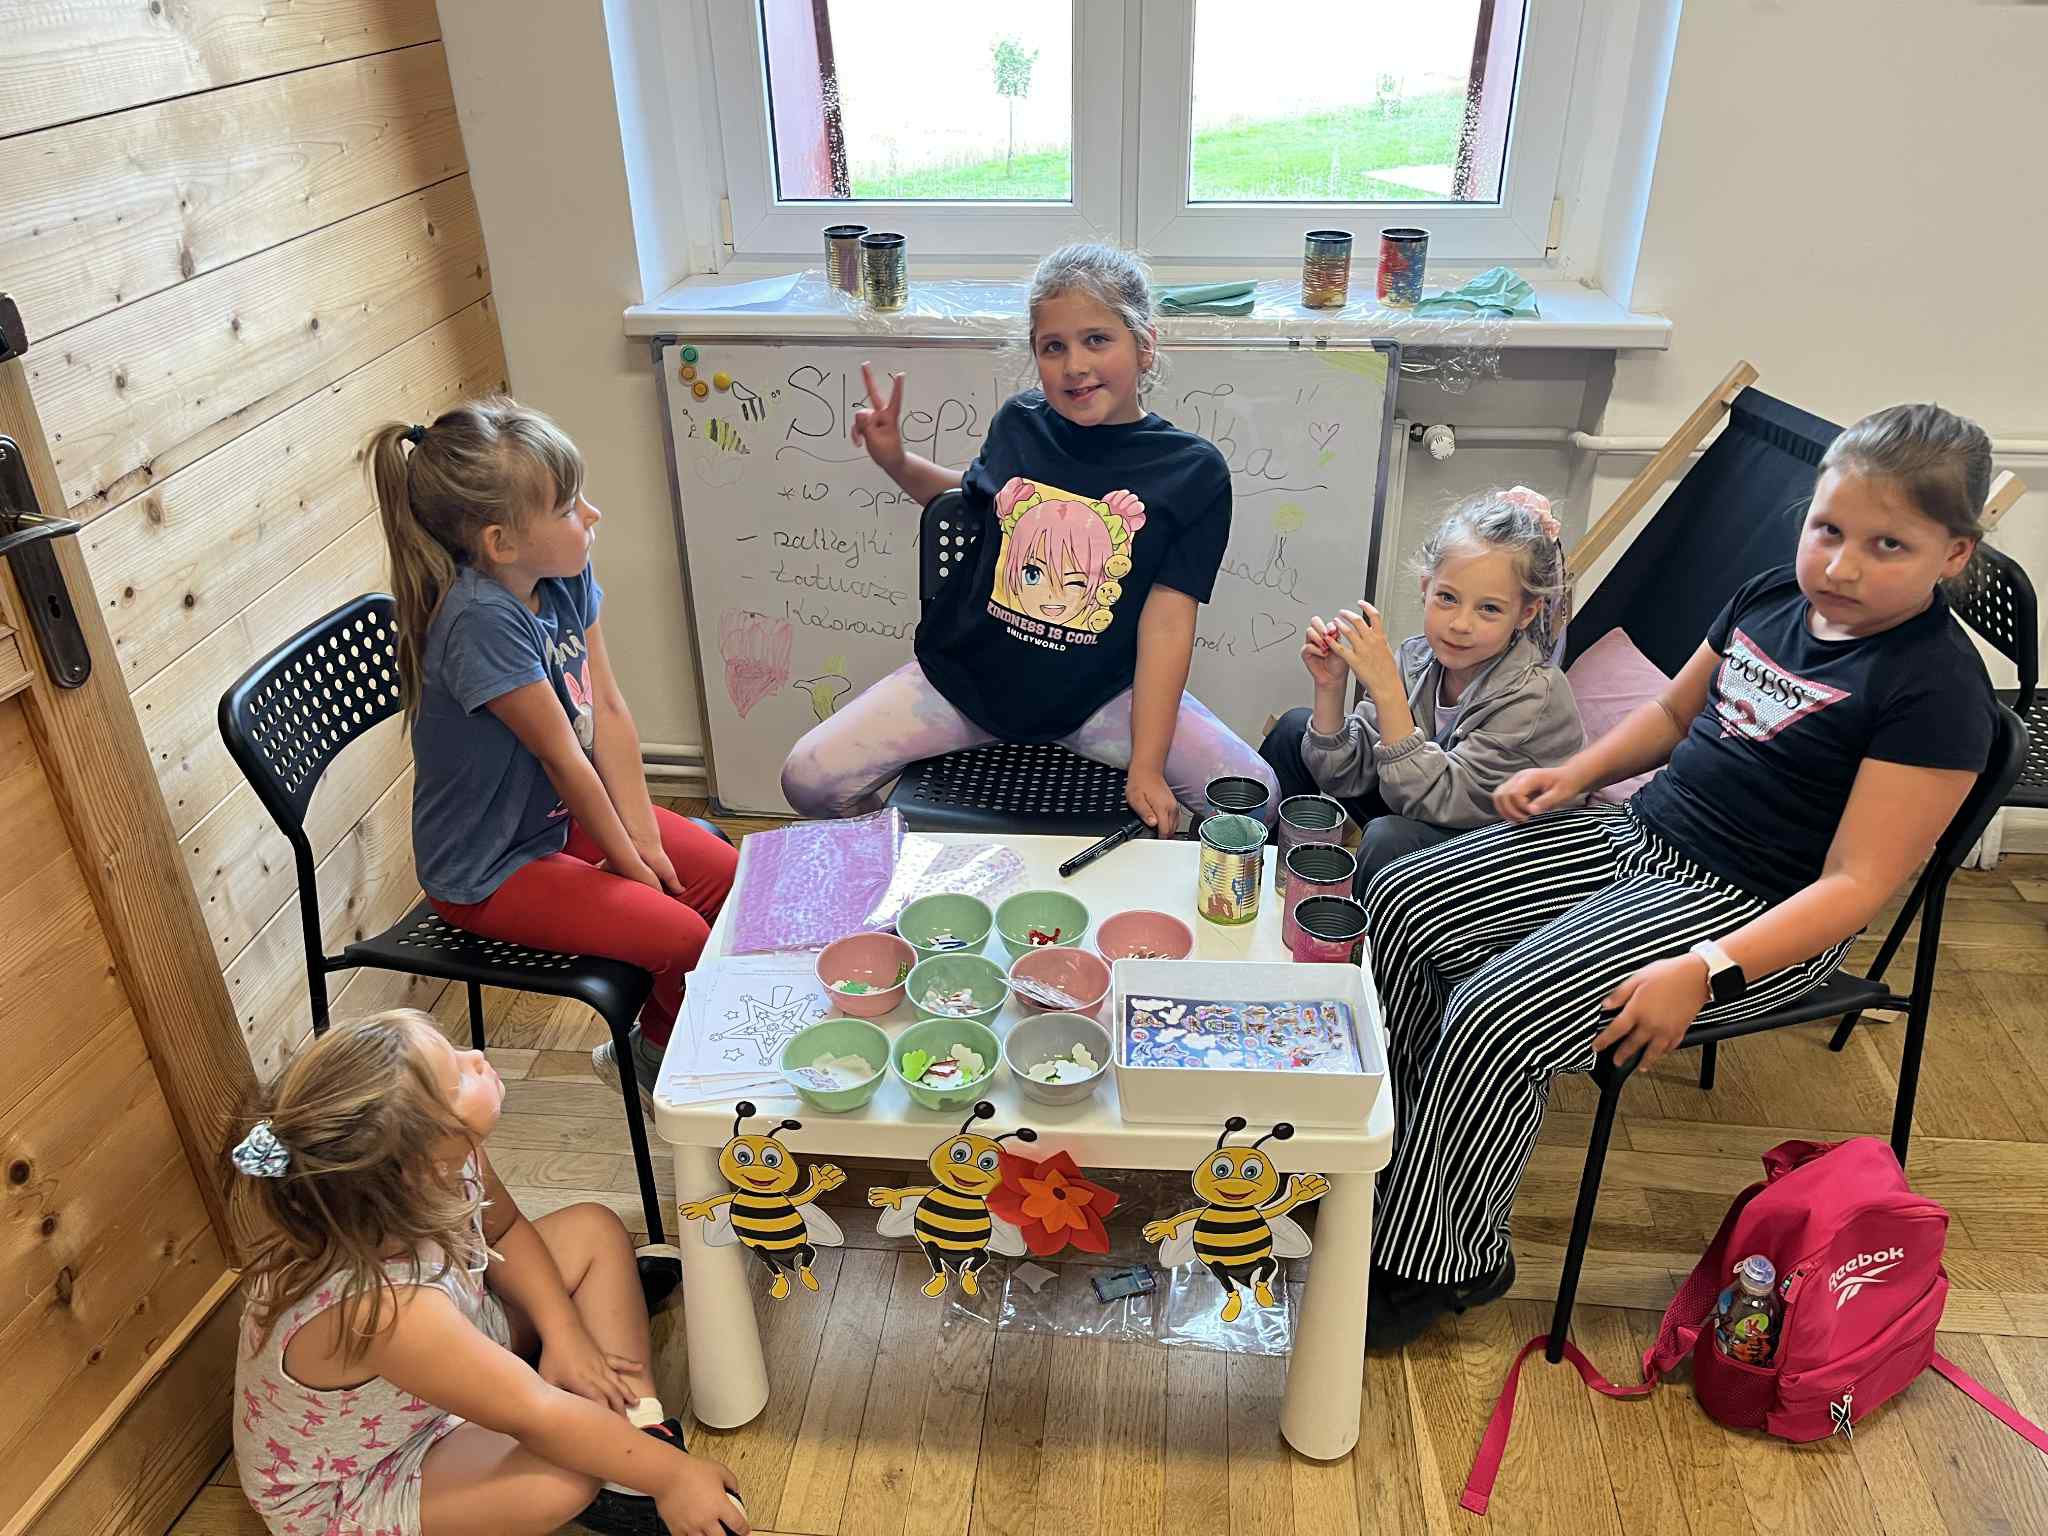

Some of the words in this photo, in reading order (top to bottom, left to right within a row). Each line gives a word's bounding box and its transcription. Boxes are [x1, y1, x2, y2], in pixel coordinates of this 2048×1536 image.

[986, 601, 1046, 636] KINDNESS
[1047, 626, 1064, 641] IS
[1065, 630, 1098, 646] COOL
[1006, 626, 1067, 652] SMILEYWORLD
[1828, 1247, 1905, 1291] Reebok
